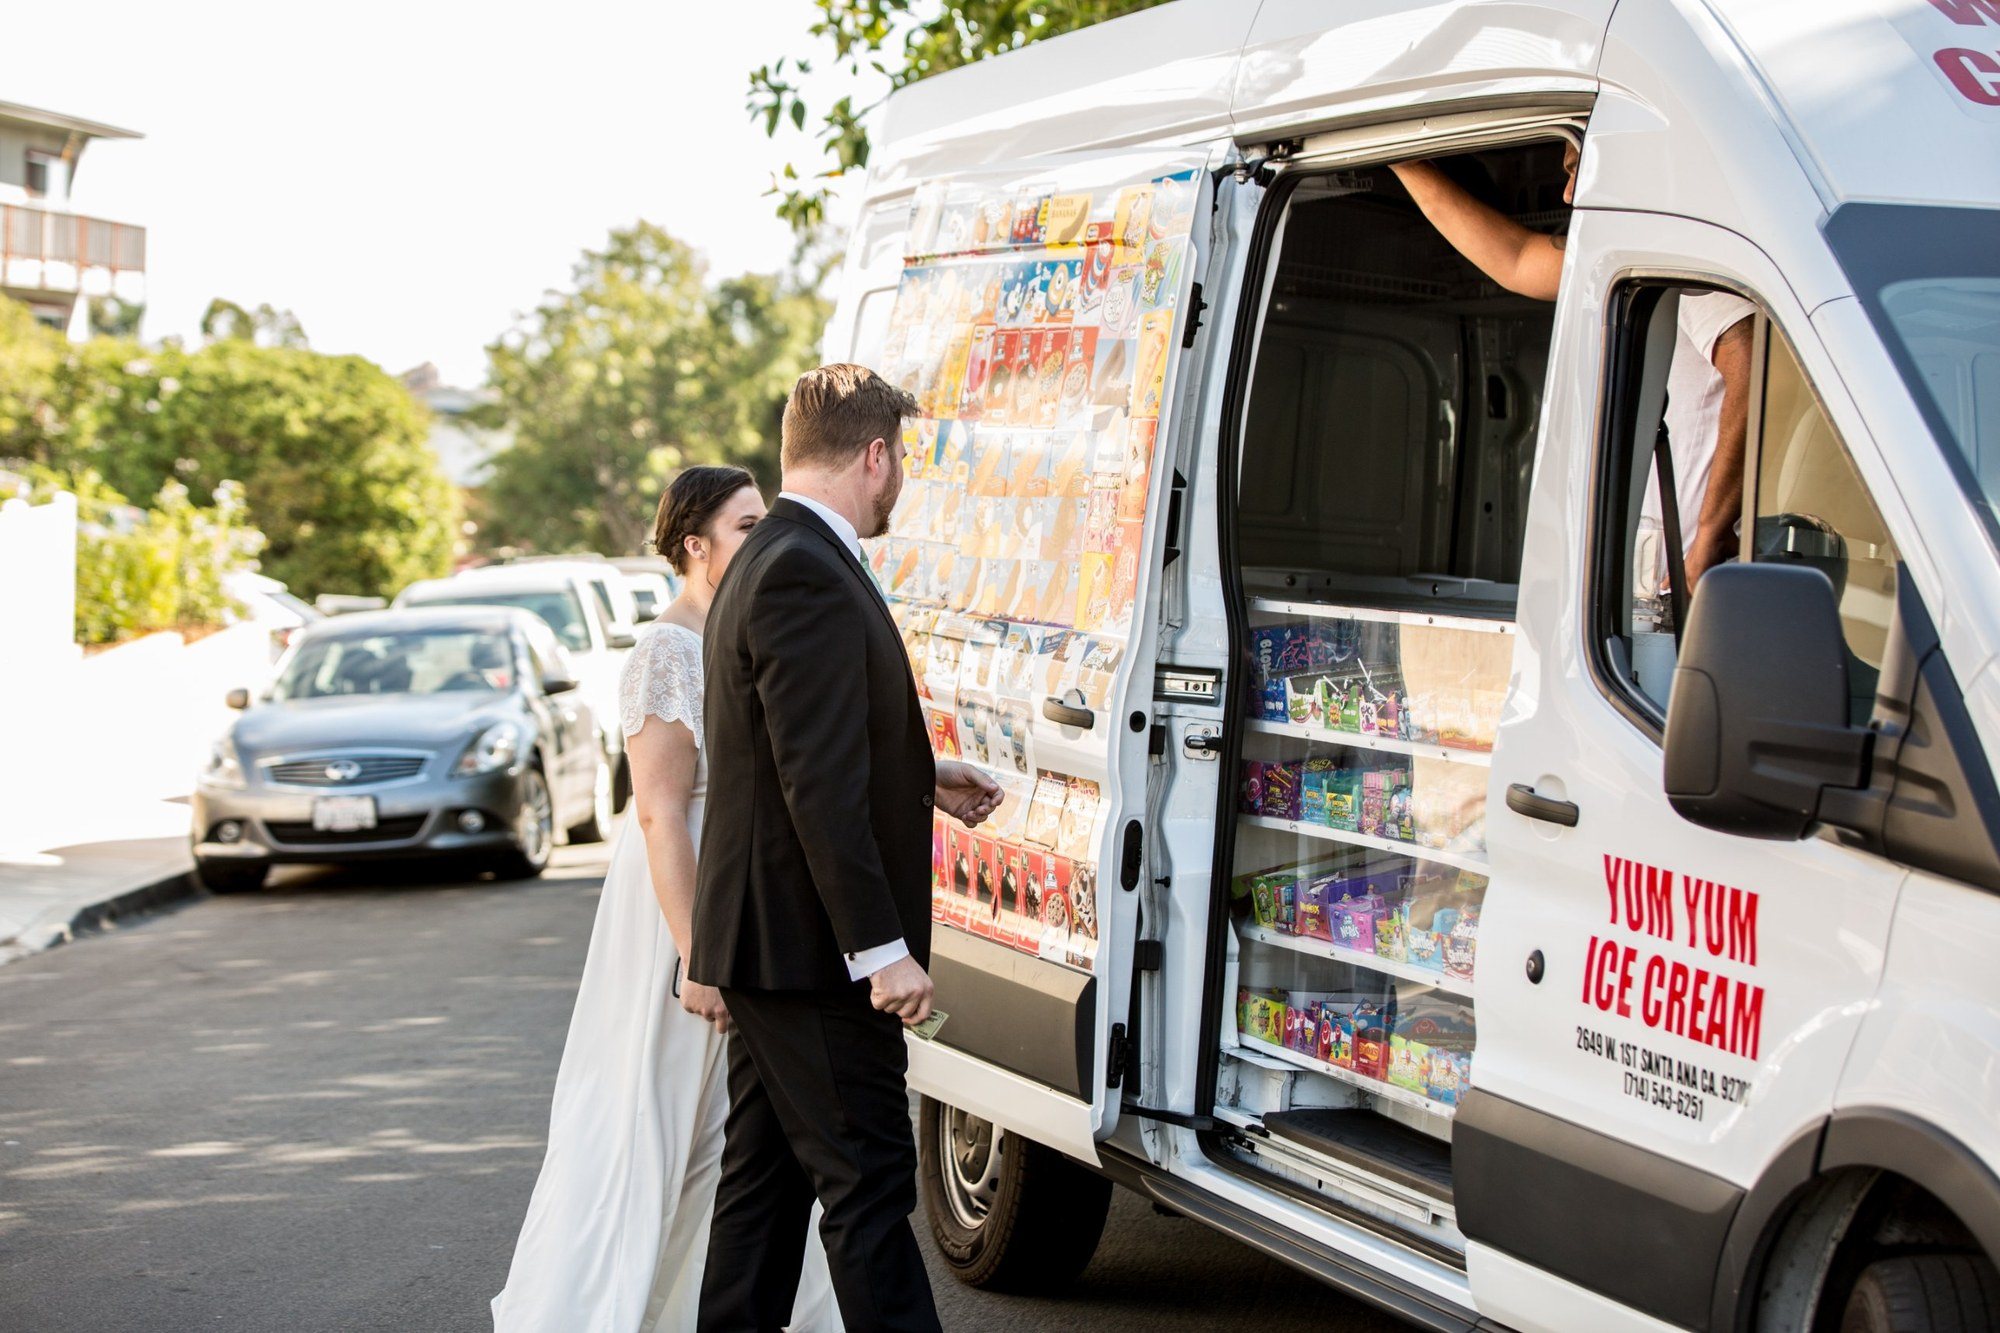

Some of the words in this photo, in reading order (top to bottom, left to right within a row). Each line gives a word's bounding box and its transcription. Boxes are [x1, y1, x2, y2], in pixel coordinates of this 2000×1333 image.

[1603, 853, 1674, 942] YUM
[1683, 874, 1760, 967] YUM
[1582, 935, 1638, 1018] ICE
[1642, 954, 1765, 1062] CREAM
[1576, 1026, 1602, 1057] 2649
[1605, 1034, 1618, 1062] W.
[1620, 1042, 1637, 1069] 1ST
[1641, 1048, 1673, 1082] SANTA
[1677, 1060, 1697, 1090] ANA
[1701, 1068, 1718, 1097] CA.
[1624, 1071, 1649, 1102] (714)
[1652, 1081, 1703, 1122] 543-6251
